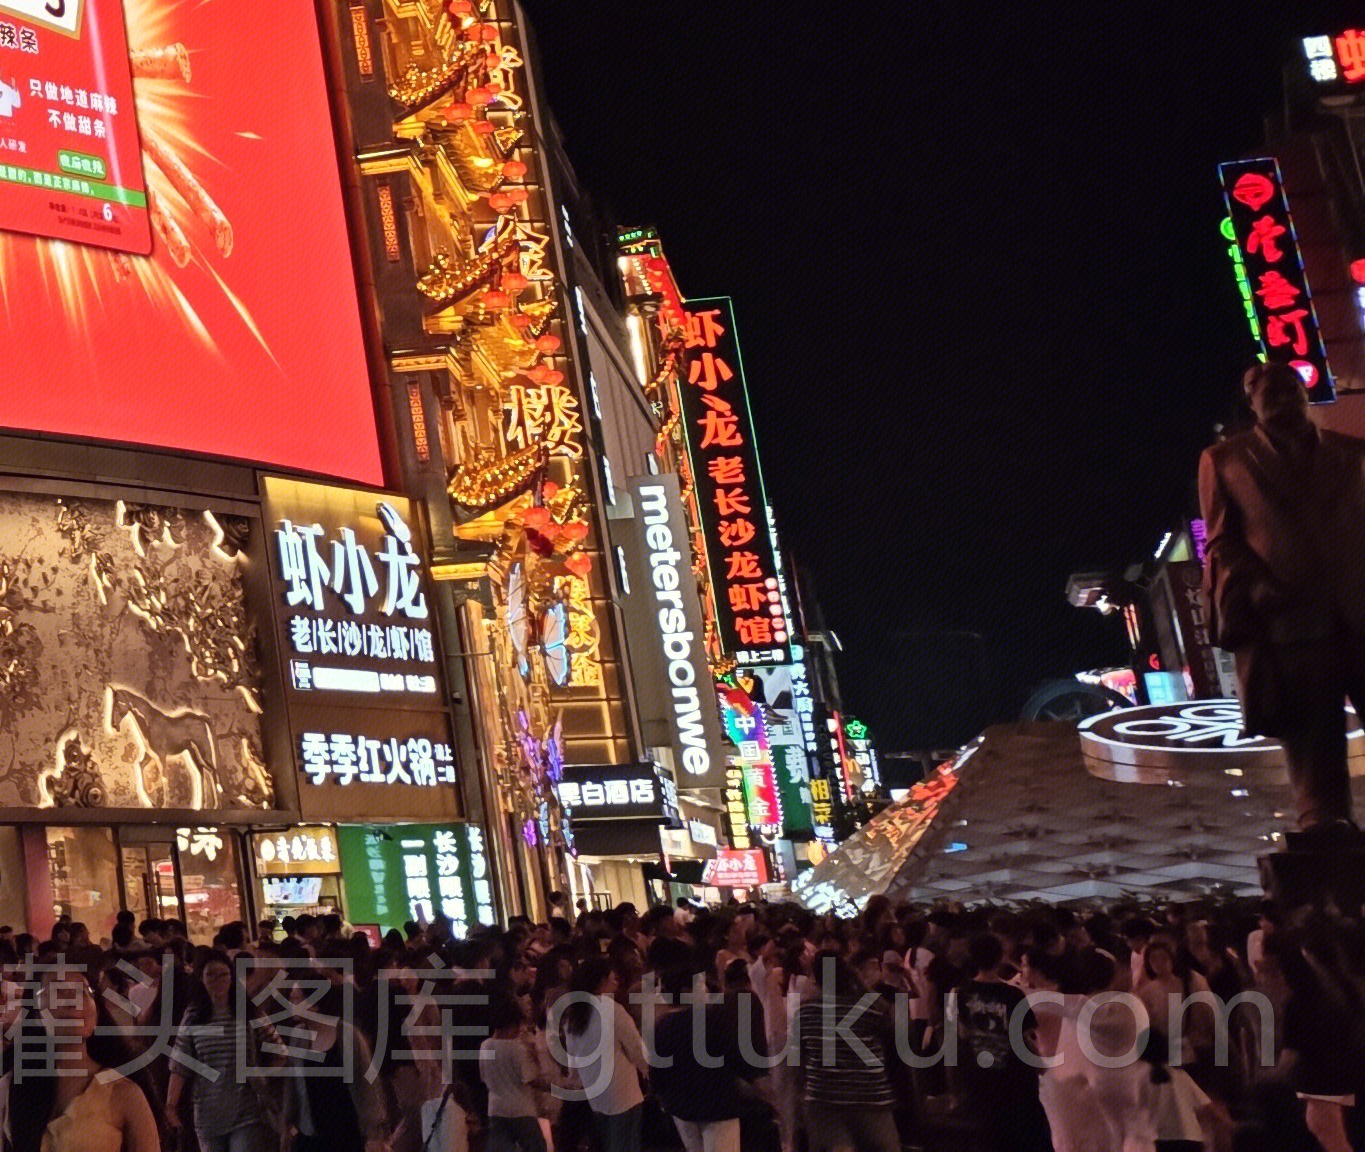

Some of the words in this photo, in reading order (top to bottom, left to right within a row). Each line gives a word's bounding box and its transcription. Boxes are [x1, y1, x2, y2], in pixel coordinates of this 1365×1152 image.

[28, 76, 119, 117] 只做地道麻辣
[47, 108, 108, 139] 不做甜条
[275, 518, 429, 620] 虾小龙
[707, 455, 773, 646] 老长沙龙虾馆
[638, 483, 708, 777] metersbonwe
[301, 732, 438, 787] 季季红火锅
[557, 779, 655, 806] 黑白酒店
